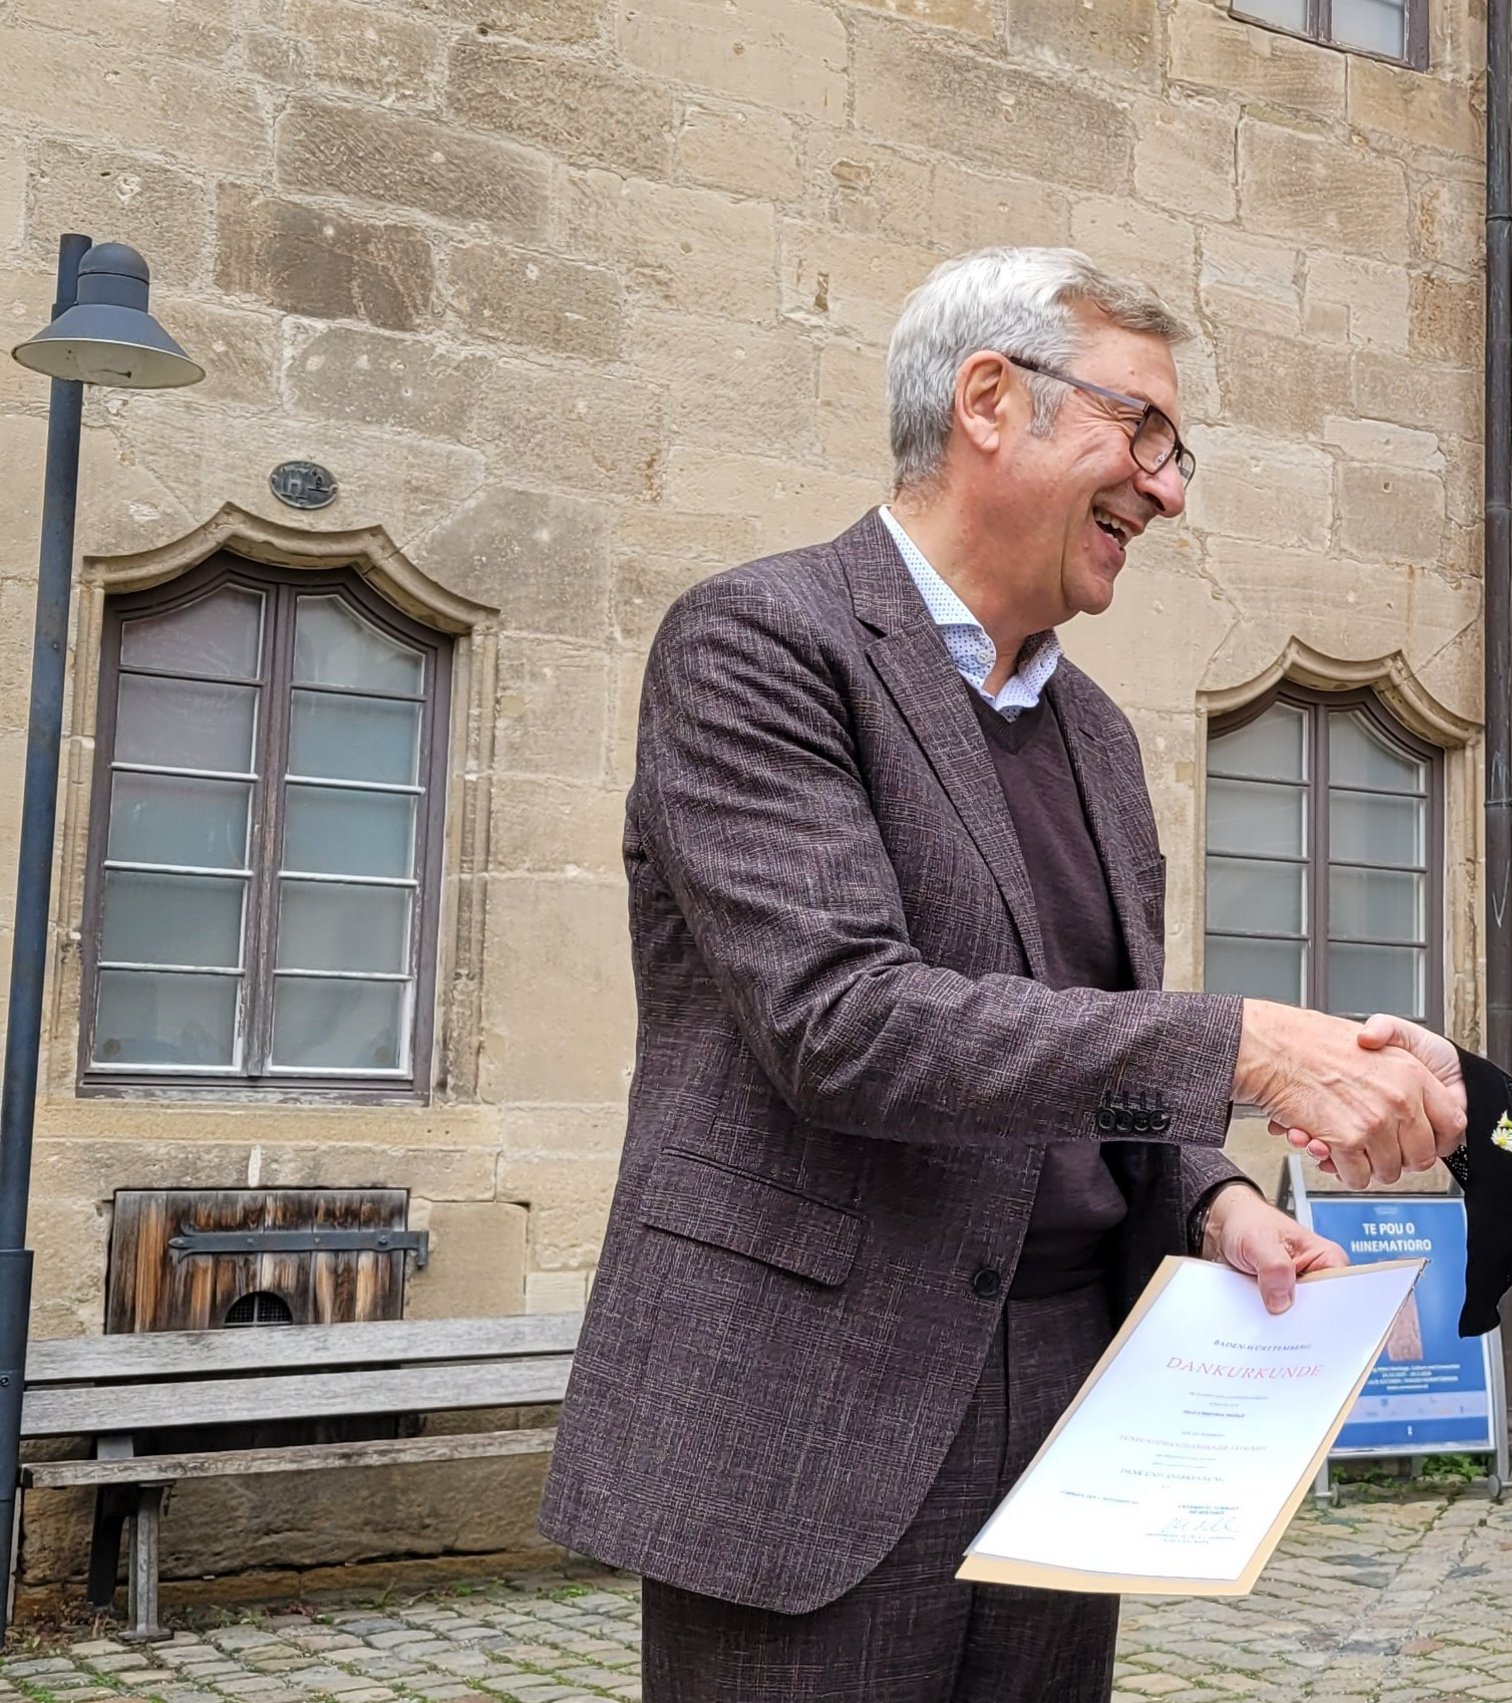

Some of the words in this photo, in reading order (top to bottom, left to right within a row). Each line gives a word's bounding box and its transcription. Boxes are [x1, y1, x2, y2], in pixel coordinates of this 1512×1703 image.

[1361, 1222, 1377, 1236] TE
[1378, 1222, 1404, 1236] POU
[1405, 1222, 1416, 1235] O
[1350, 1238, 1433, 1253] HINEMATIORO
[1165, 1356, 1323, 1380] DANKURKUNDE
